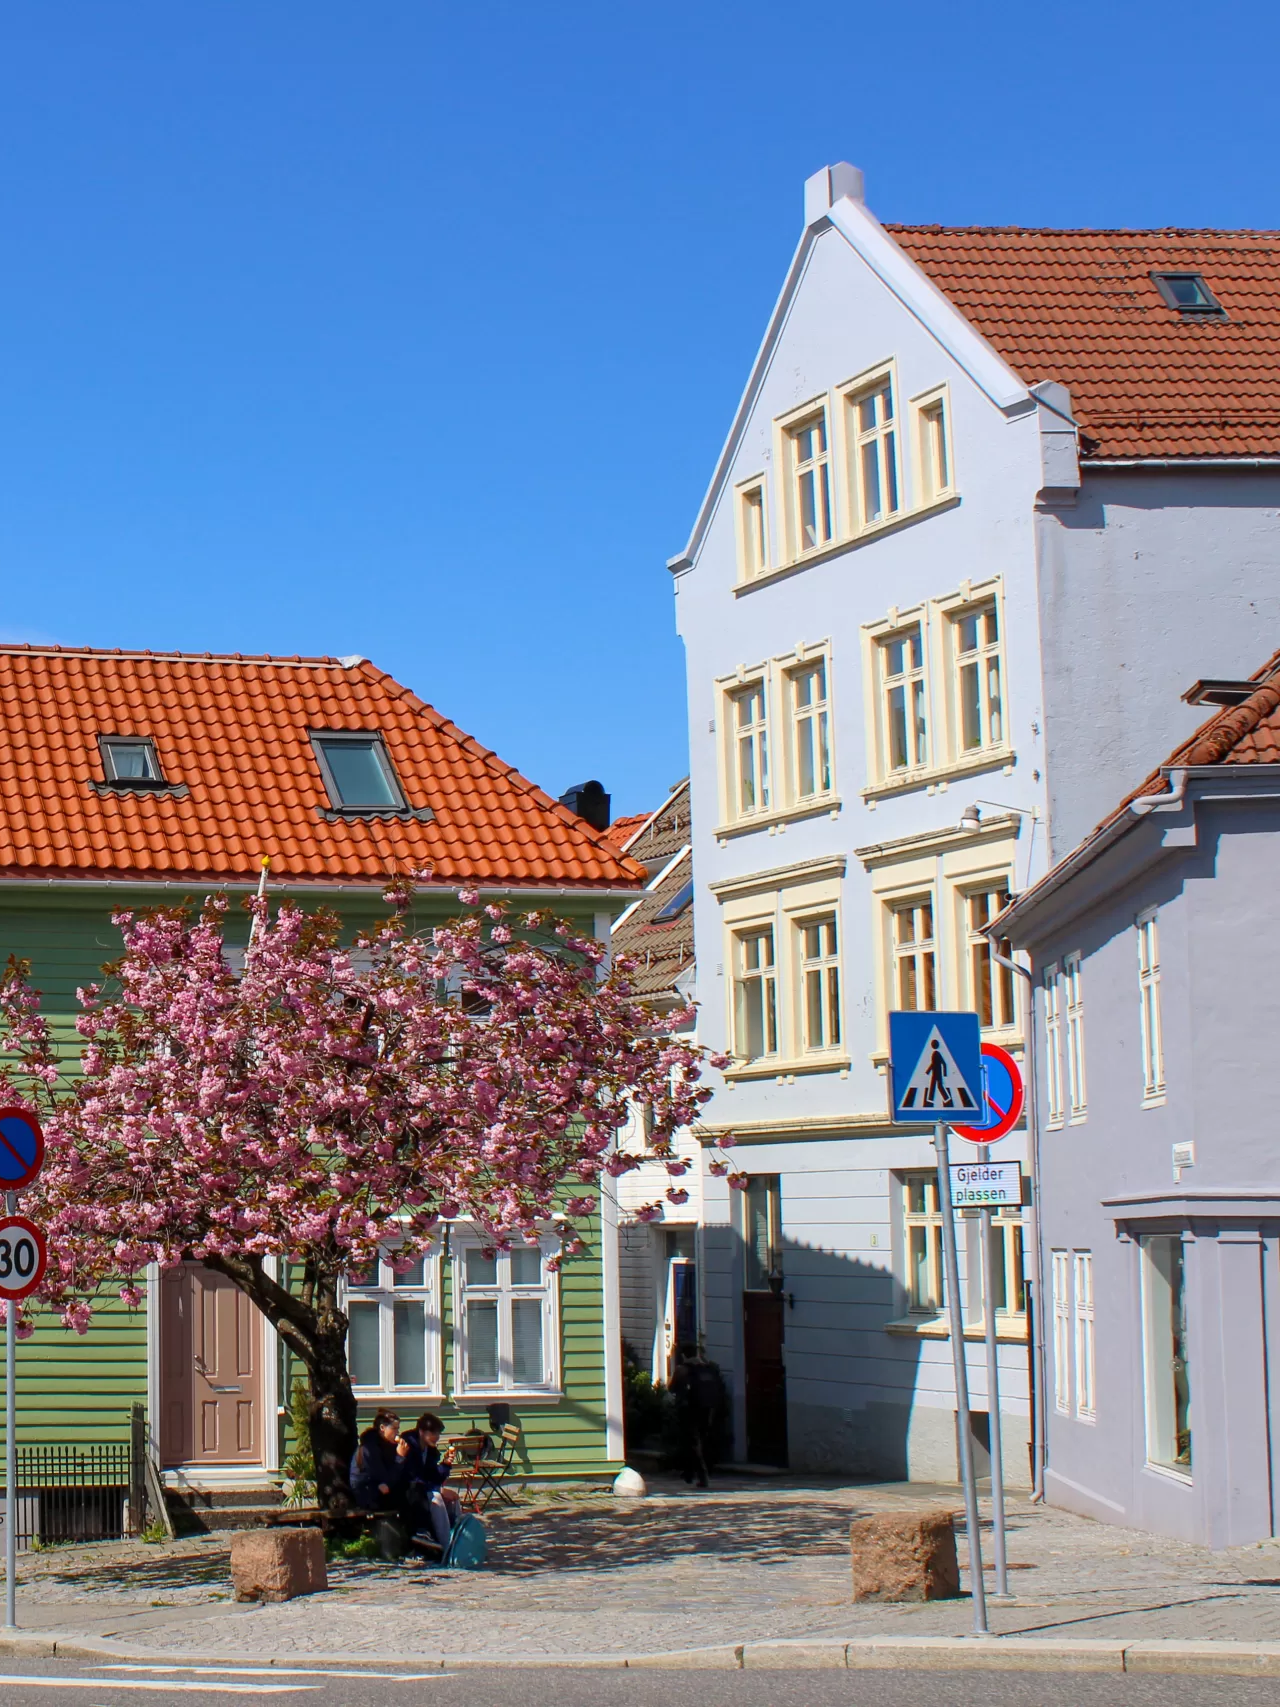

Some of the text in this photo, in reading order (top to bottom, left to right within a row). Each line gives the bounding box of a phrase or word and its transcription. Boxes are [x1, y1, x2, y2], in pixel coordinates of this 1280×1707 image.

[957, 1167, 1004, 1185] Gjelder
[956, 1187, 1006, 1204] plassen
[665, 1334, 671, 1349] 5
